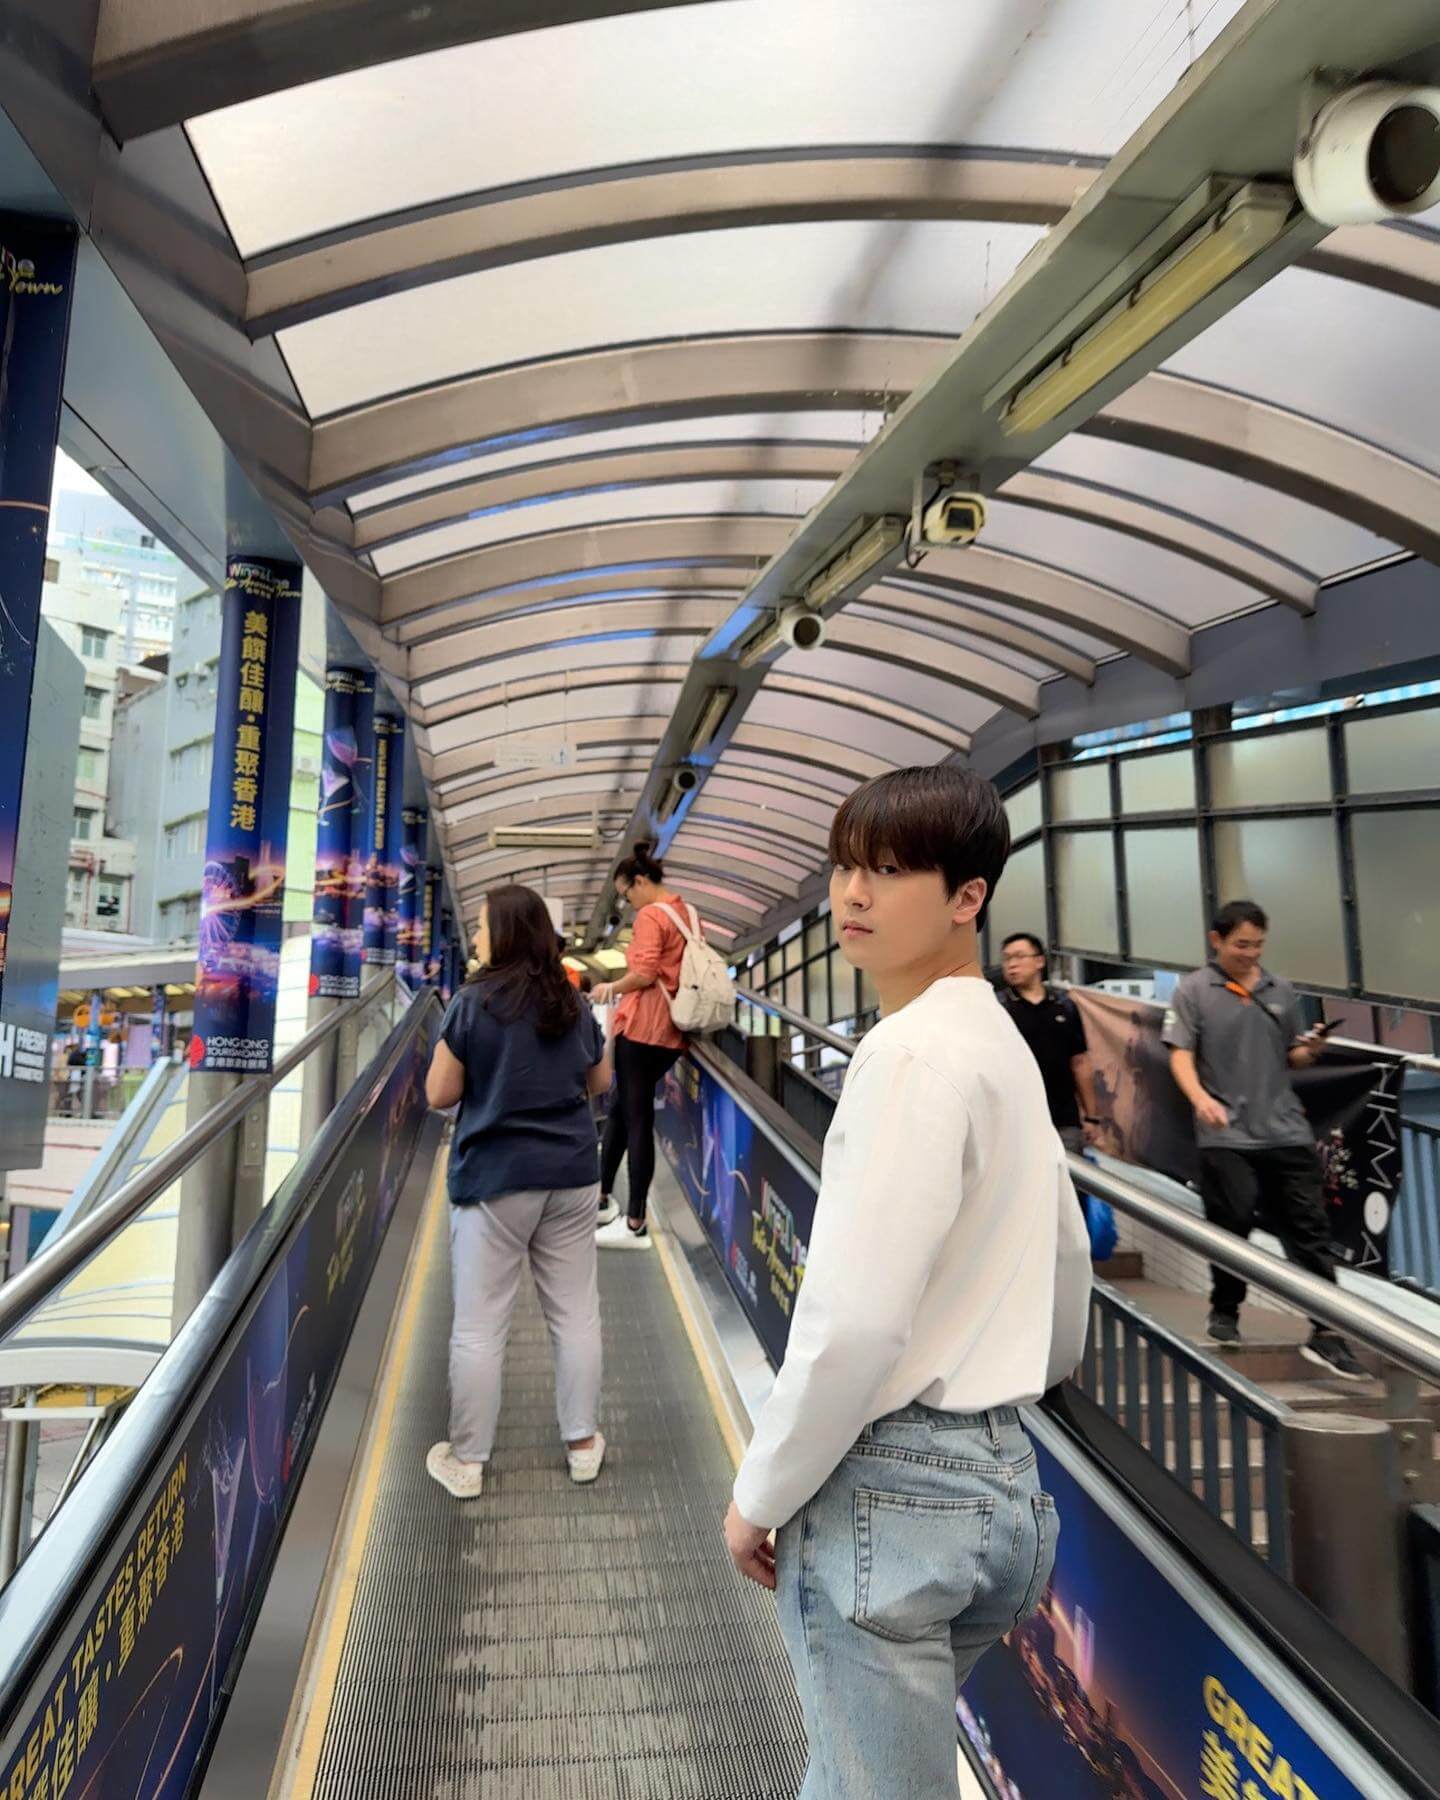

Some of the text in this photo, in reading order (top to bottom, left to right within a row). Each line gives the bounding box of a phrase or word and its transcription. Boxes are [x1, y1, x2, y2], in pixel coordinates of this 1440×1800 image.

[207, 1036, 269, 1050] HONG ONG
[241, 1048, 269, 1060] OARD
[0, 1452, 188, 1800] REAT TASTES RETURN
